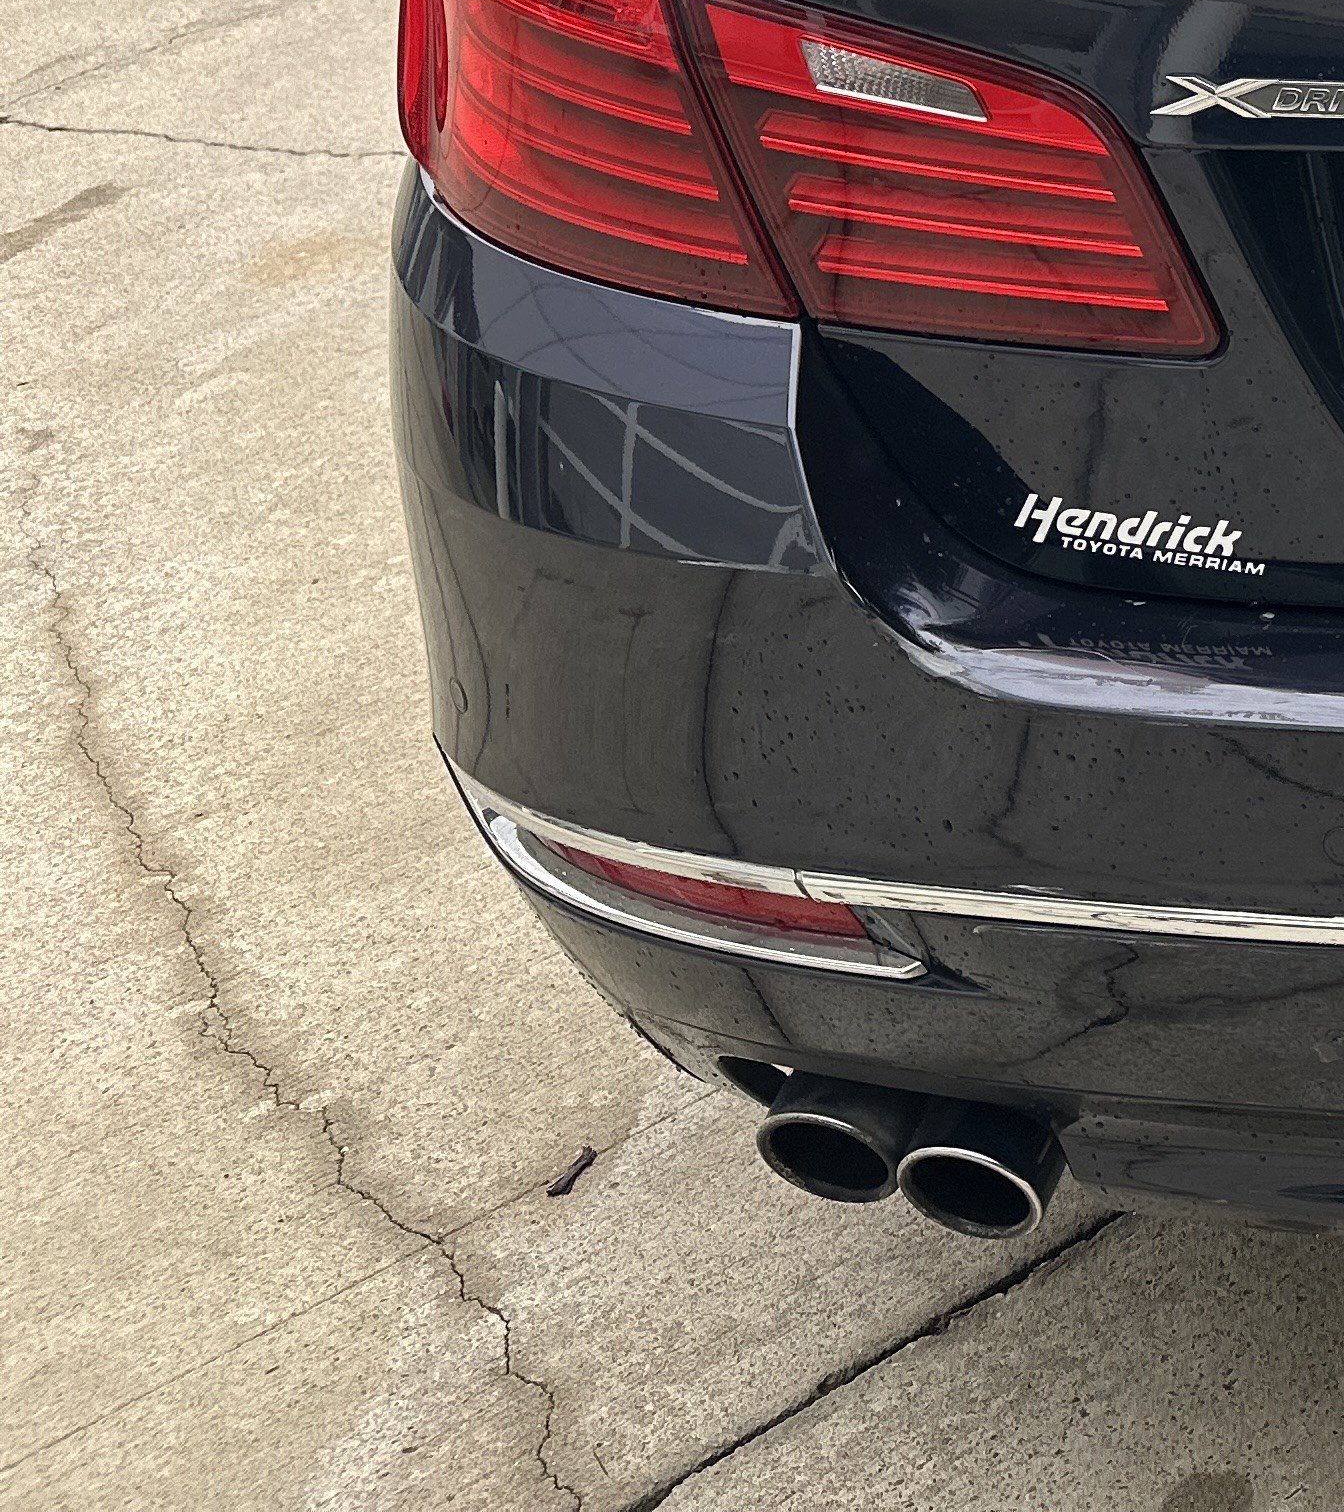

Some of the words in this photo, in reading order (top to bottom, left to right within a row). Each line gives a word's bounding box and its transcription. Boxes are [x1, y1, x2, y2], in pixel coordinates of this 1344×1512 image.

[1014, 493, 1242, 556] Hendrick
[1061, 536, 1143, 560] TOYOTA
[1152, 549, 1266, 576] MERRIAM
